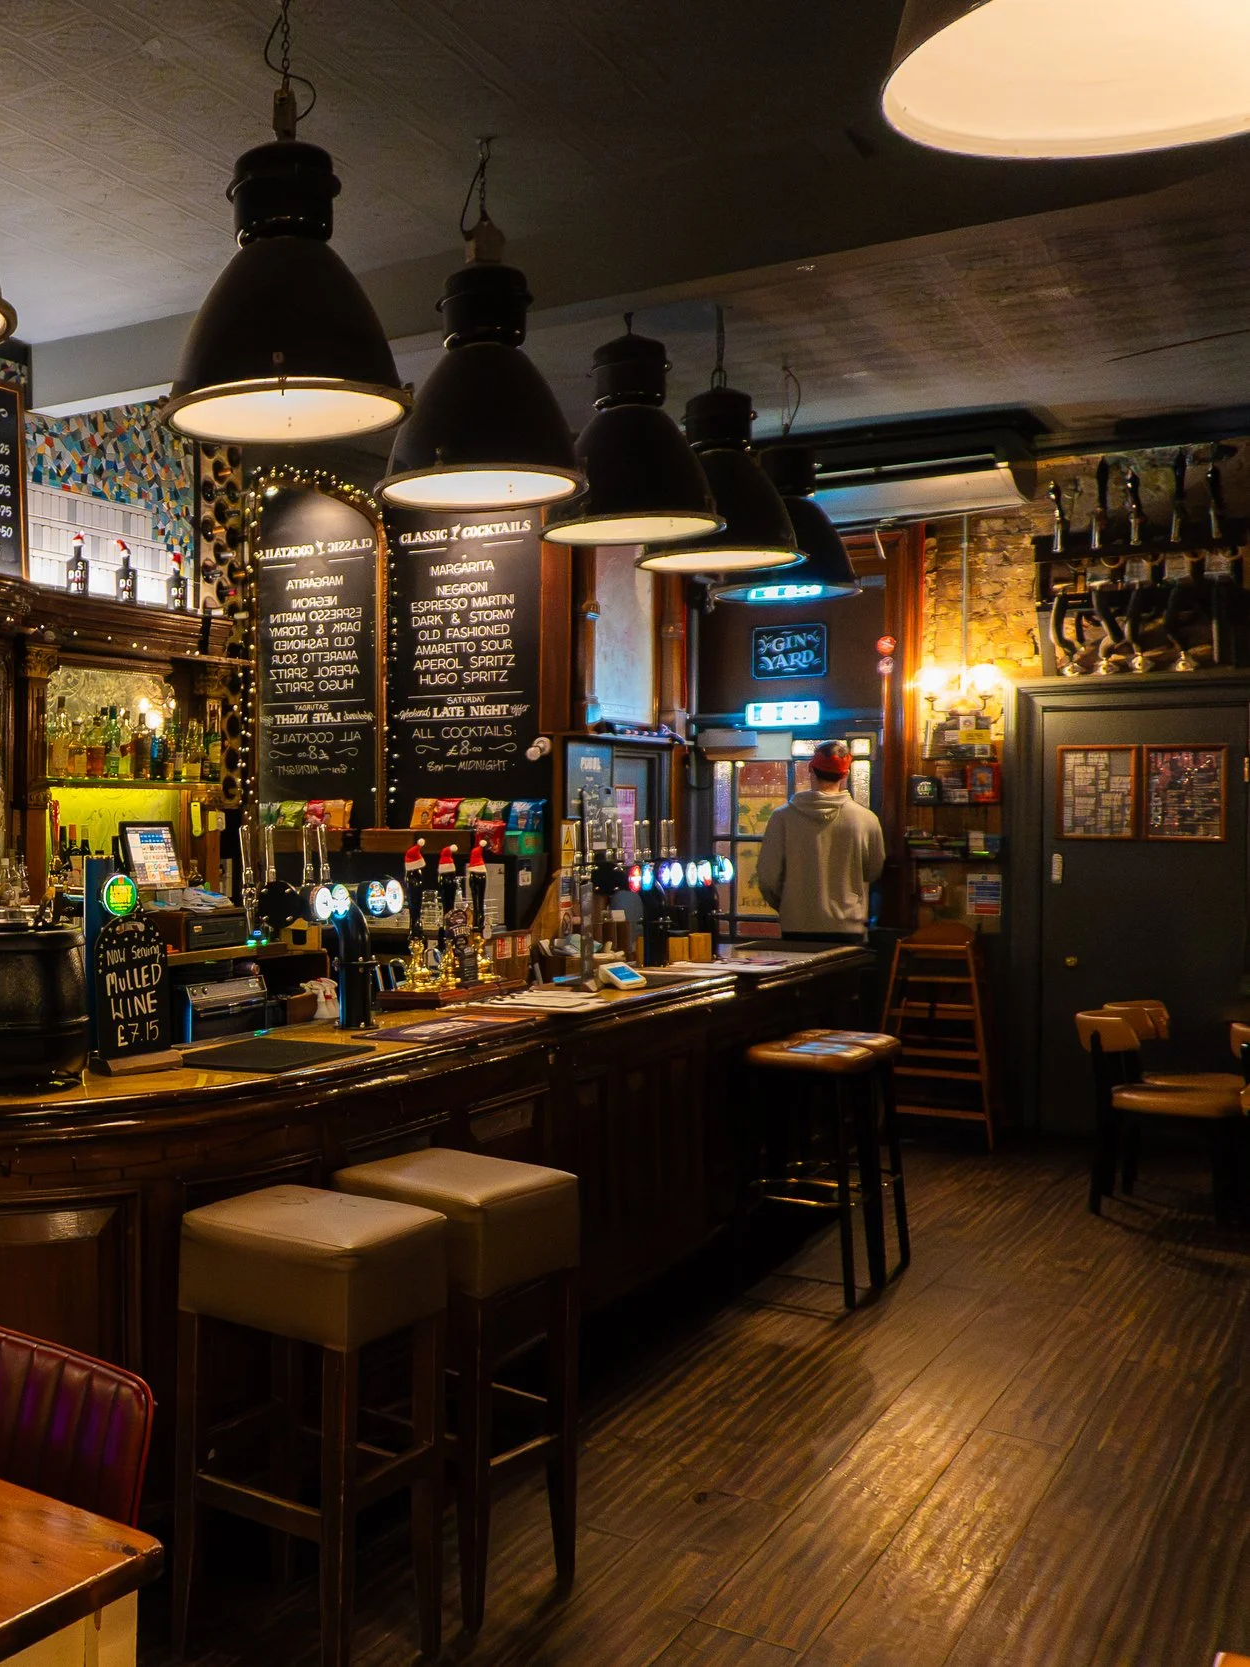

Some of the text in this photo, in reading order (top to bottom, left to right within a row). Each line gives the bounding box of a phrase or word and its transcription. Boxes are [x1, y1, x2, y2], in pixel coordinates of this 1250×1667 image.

[400, 519, 531, 546] CLASSIC COCKTAILS
[430, 560, 495, 577] MARGARITA
[436, 582, 488, 597] NEGRONI
[411, 594, 515, 613] ESPRESSO MARTINI
[412, 609, 515, 628] DARK & STORMY
[418, 624, 510, 641] OLD FASHIONED
[414, 639, 513, 656] AMARETTO SOUR
[772, 632, 807, 652] GIN
[413, 654, 516, 671] APEROL SPRITZ
[758, 649, 815, 671] YARD
[419, 670, 508, 685] HUGO SPRITZ
[446, 696, 486, 705] SATURDAY
[432, 706, 465, 718] LATE
[470, 704, 510, 717] NIGHT
[411, 728, 435, 739] ALL
[106, 943, 162, 967] NOW Serving
[110, 990, 158, 1021] WINE
[117, 1019, 159, 1047] £7.15
